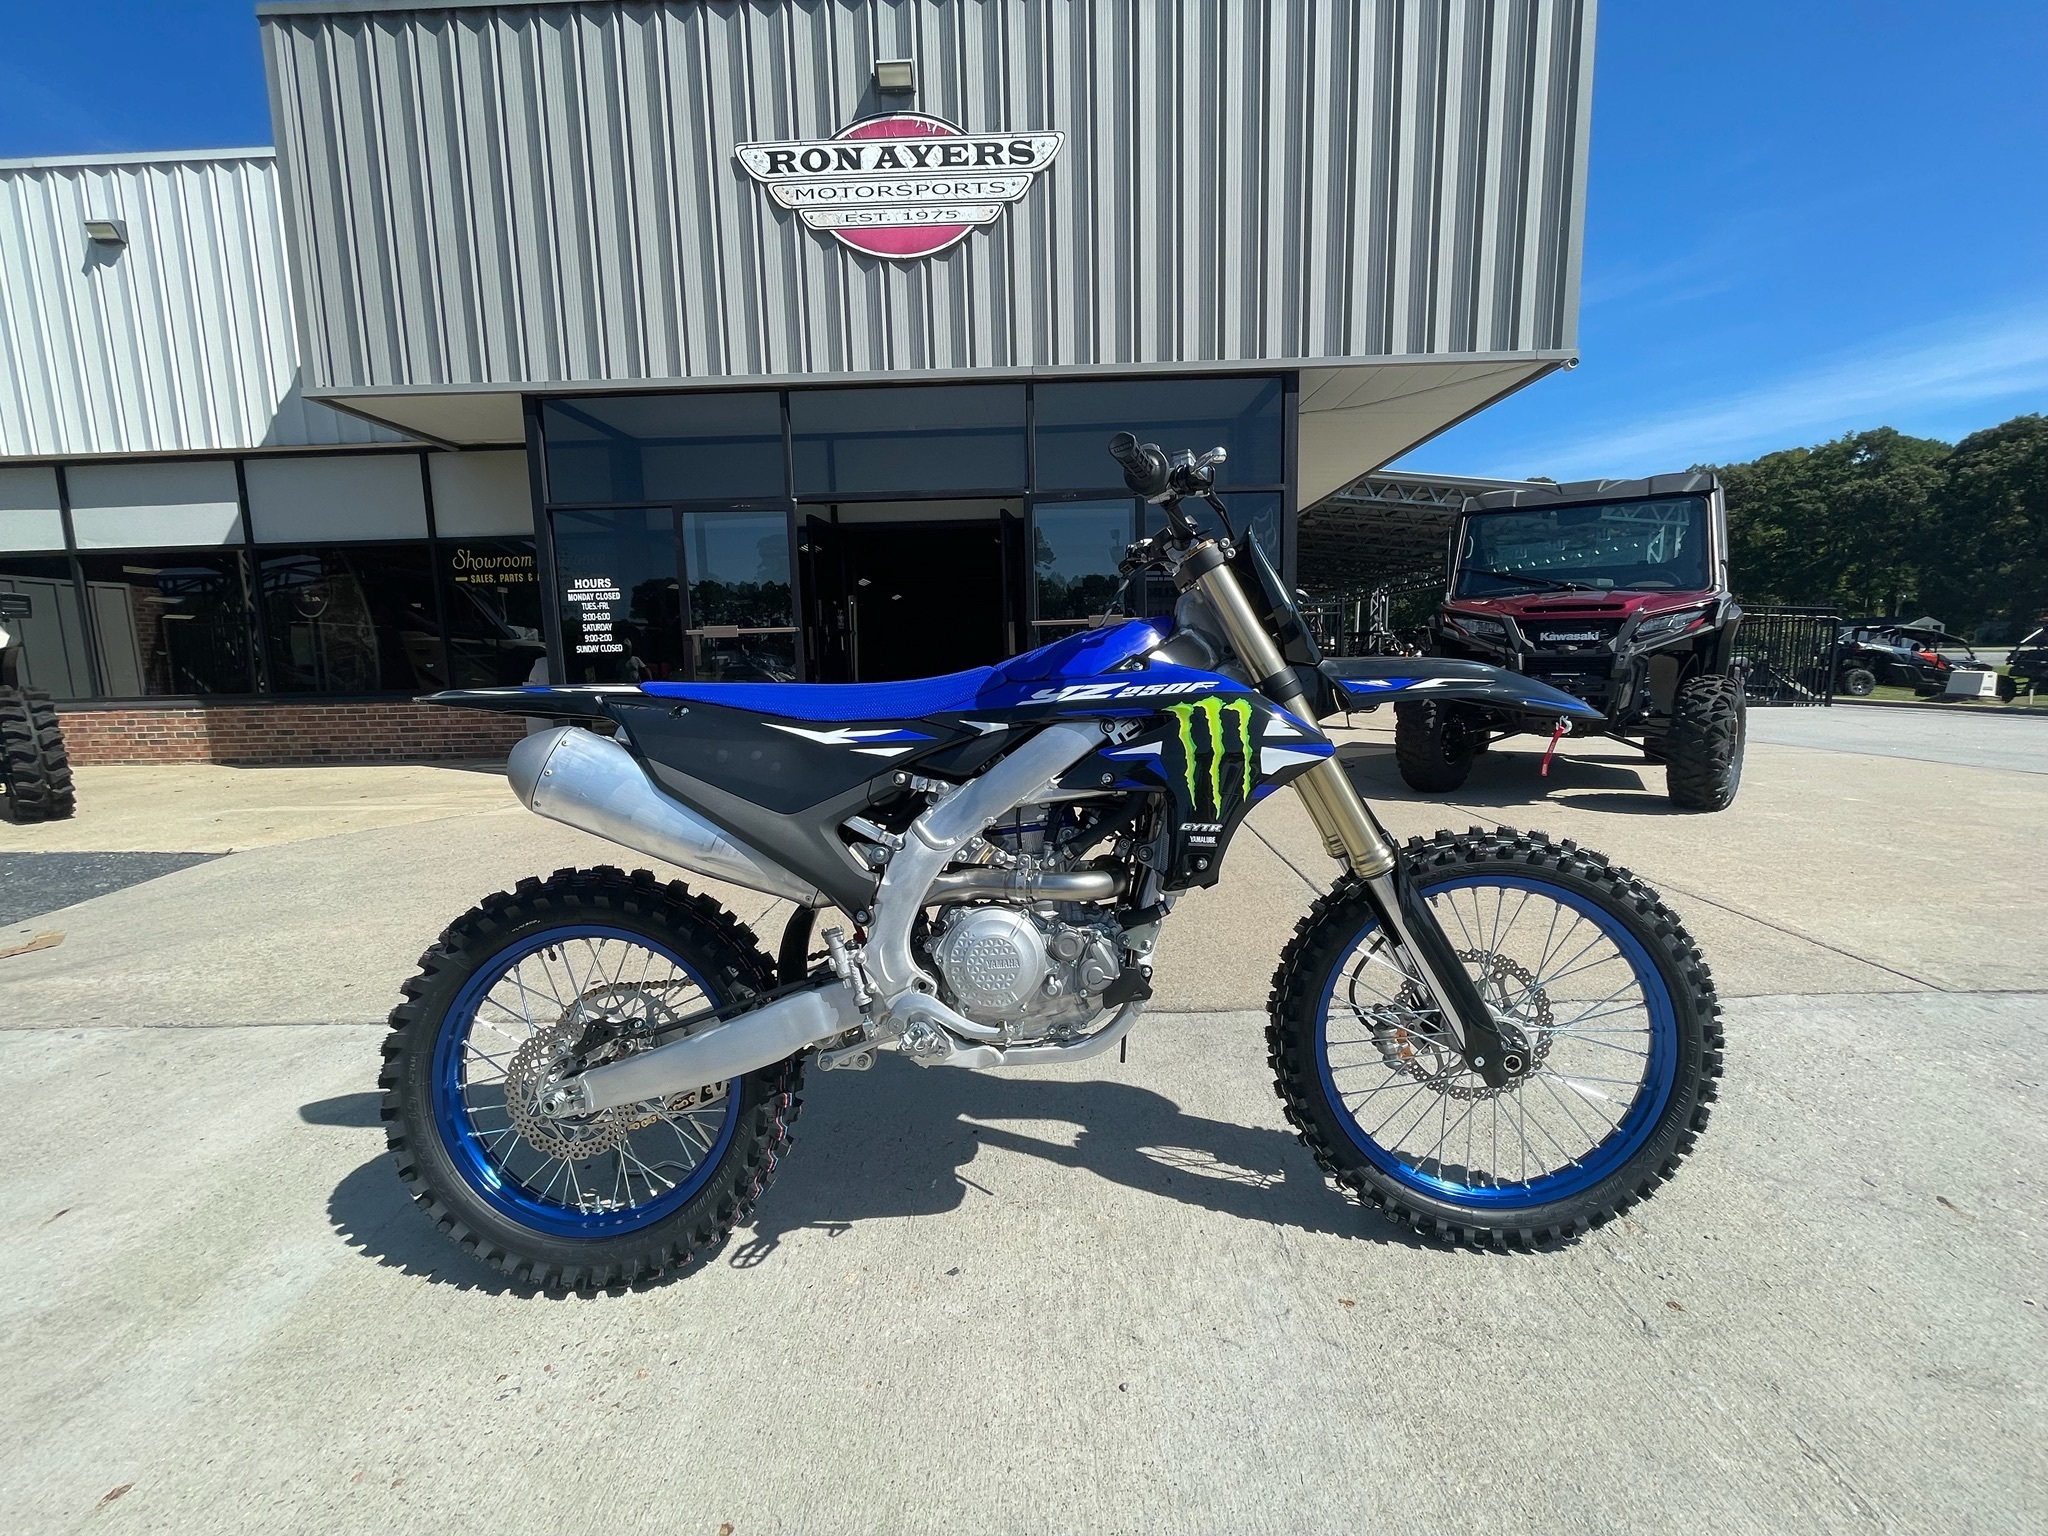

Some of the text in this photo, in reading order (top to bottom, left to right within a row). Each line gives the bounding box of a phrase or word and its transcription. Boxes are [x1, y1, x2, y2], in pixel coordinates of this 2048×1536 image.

[766, 140, 1036, 174] RON AYERS
[795, 181, 1006, 200] MOTORSPORTS
[845, 210, 958, 223] EST. 1975
[452, 548, 533, 571] Showroom
[499, 573, 524, 583] PARTS
[527, 572, 533, 582] &
[574, 578, 612, 589] HOURS
[567, 592, 621, 601] MONDAY CLOSED
[582, 613, 611, 621] 9:00-6:00
[582, 623, 613, 632] SATURDAY
[584, 634, 613, 643] 9:00-2:00
[1540, 631, 1599, 641] Kawasaki
[576, 644, 623, 653] SUNDAY CLOSED
[1179, 822, 1224, 833] GYTR
[1189, 835, 1216, 844] YAMALUBE
[985, 958, 1020, 969] YAMAHA
